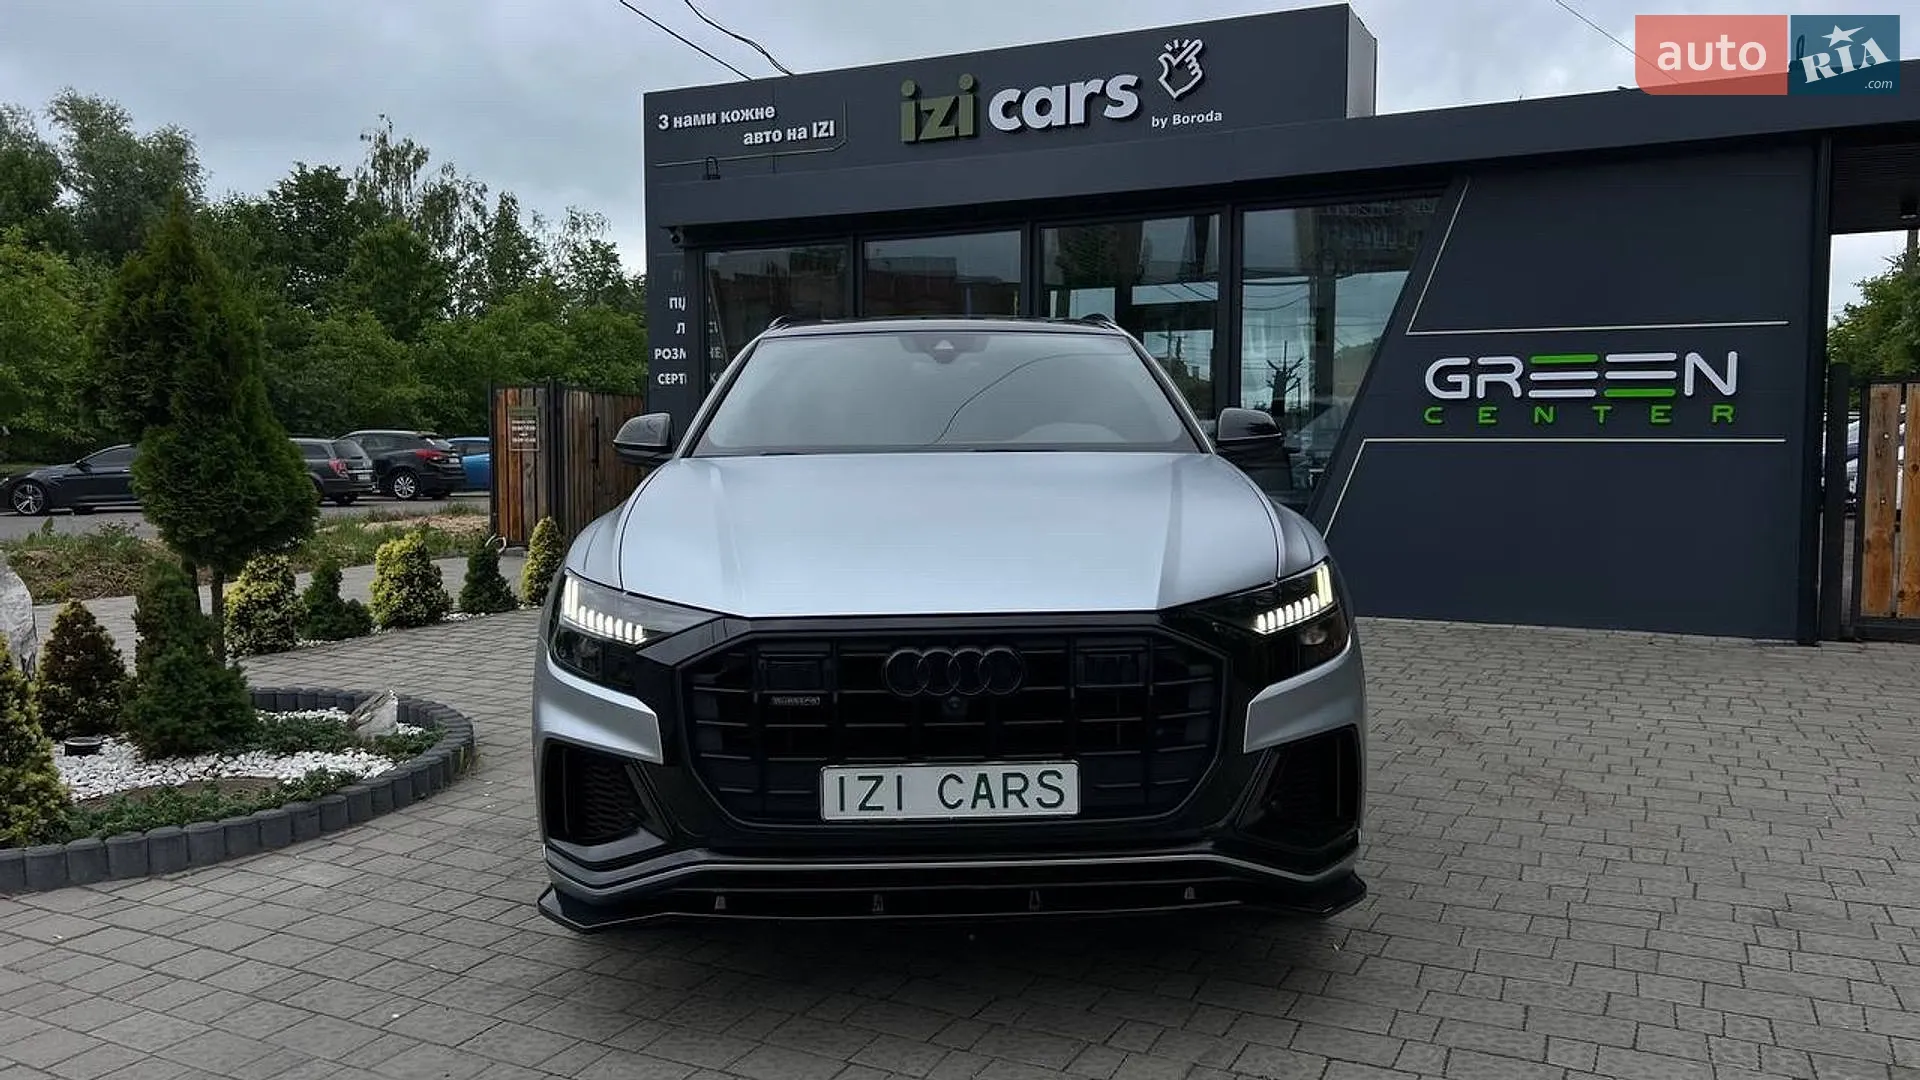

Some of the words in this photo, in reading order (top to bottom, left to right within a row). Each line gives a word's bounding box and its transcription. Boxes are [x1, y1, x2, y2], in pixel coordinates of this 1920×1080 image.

[658, 115, 668, 129] З
[673, 112, 716, 128] нами
[721, 106, 775, 124] кожне
[901, 74, 974, 142] izi
[988, 75, 1139, 131] cars
[1152, 115, 1168, 128] by
[1172, 110, 1223, 125] Boroda
[744, 131, 782, 145] авто
[787, 127, 808, 141] на
[812, 120, 835, 138] IZI
[1425, 351, 1738, 399] GREEN
[1423, 405, 1735, 424] CENTER
[838, 775, 903, 811] IZI
[937, 770, 1065, 810] CARS
